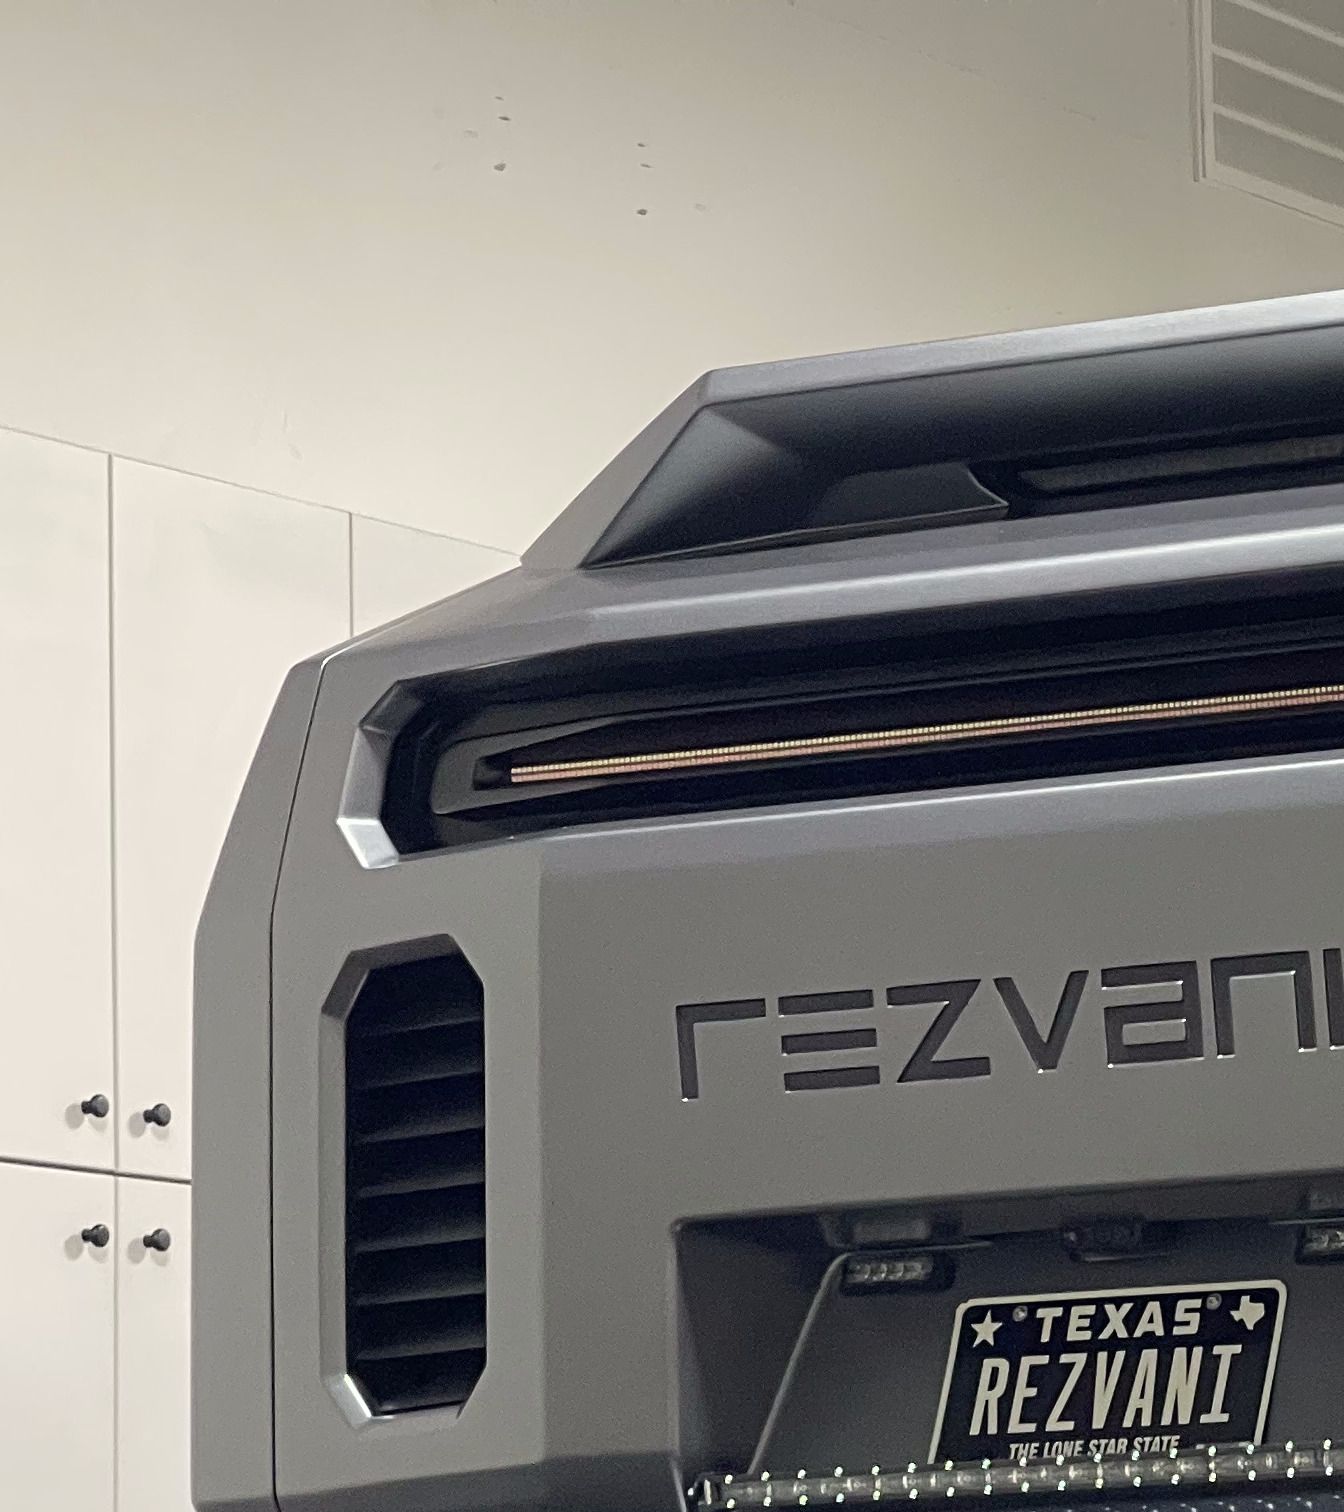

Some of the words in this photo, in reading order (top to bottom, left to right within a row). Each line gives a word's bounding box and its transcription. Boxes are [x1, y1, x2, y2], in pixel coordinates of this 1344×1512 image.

[1036, 1298, 1202, 1343] TEXAS
[968, 1344, 1243, 1436] REZVANI
[1009, 1442, 1040, 1460] THE
[1043, 1439, 1085, 1458] LONE
[1087, 1436, 1128, 1456] STAR
[1133, 1434, 1181, 1453] STATE
